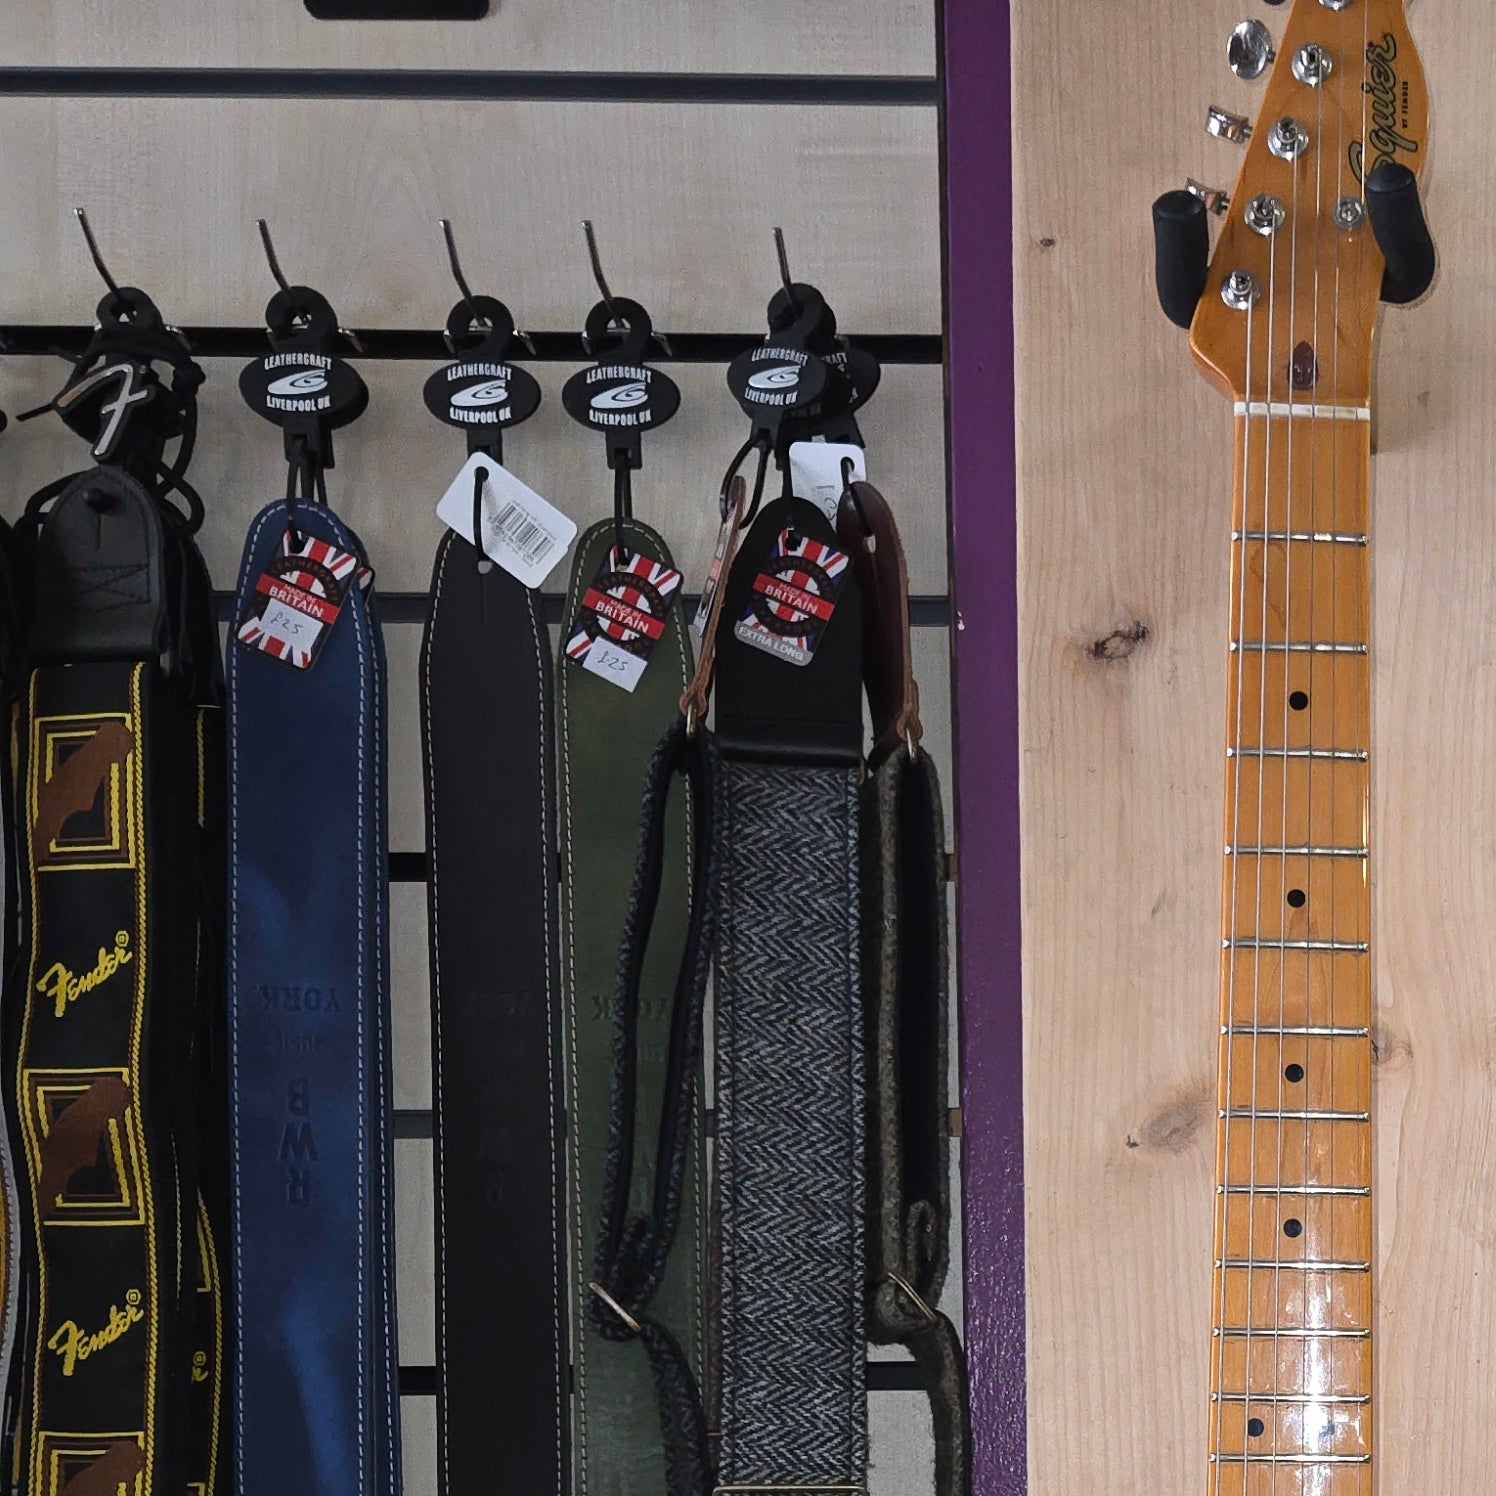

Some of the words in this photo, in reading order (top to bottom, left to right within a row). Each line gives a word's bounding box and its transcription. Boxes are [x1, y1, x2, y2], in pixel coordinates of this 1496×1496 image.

[266, 394, 317, 412] LIVERPOOL
[317, 394, 331, 410] UK
[744, 387, 784, 406] LIVERPOOL
[785, 390, 798, 405] UK
[449, 406, 499, 424] LIVERPOOL
[498, 406, 512, 422] UK
[588, 408, 639, 426] LIVERPOOL
[639, 408, 652, 424] UK
[268, 585, 324, 618] BRITAIN
[764, 584, 819, 615] BRITAIN
[594, 600, 650, 634] BRITAIN
[737, 625, 774, 648] EXTRA
[772, 640, 805, 661] LONG
